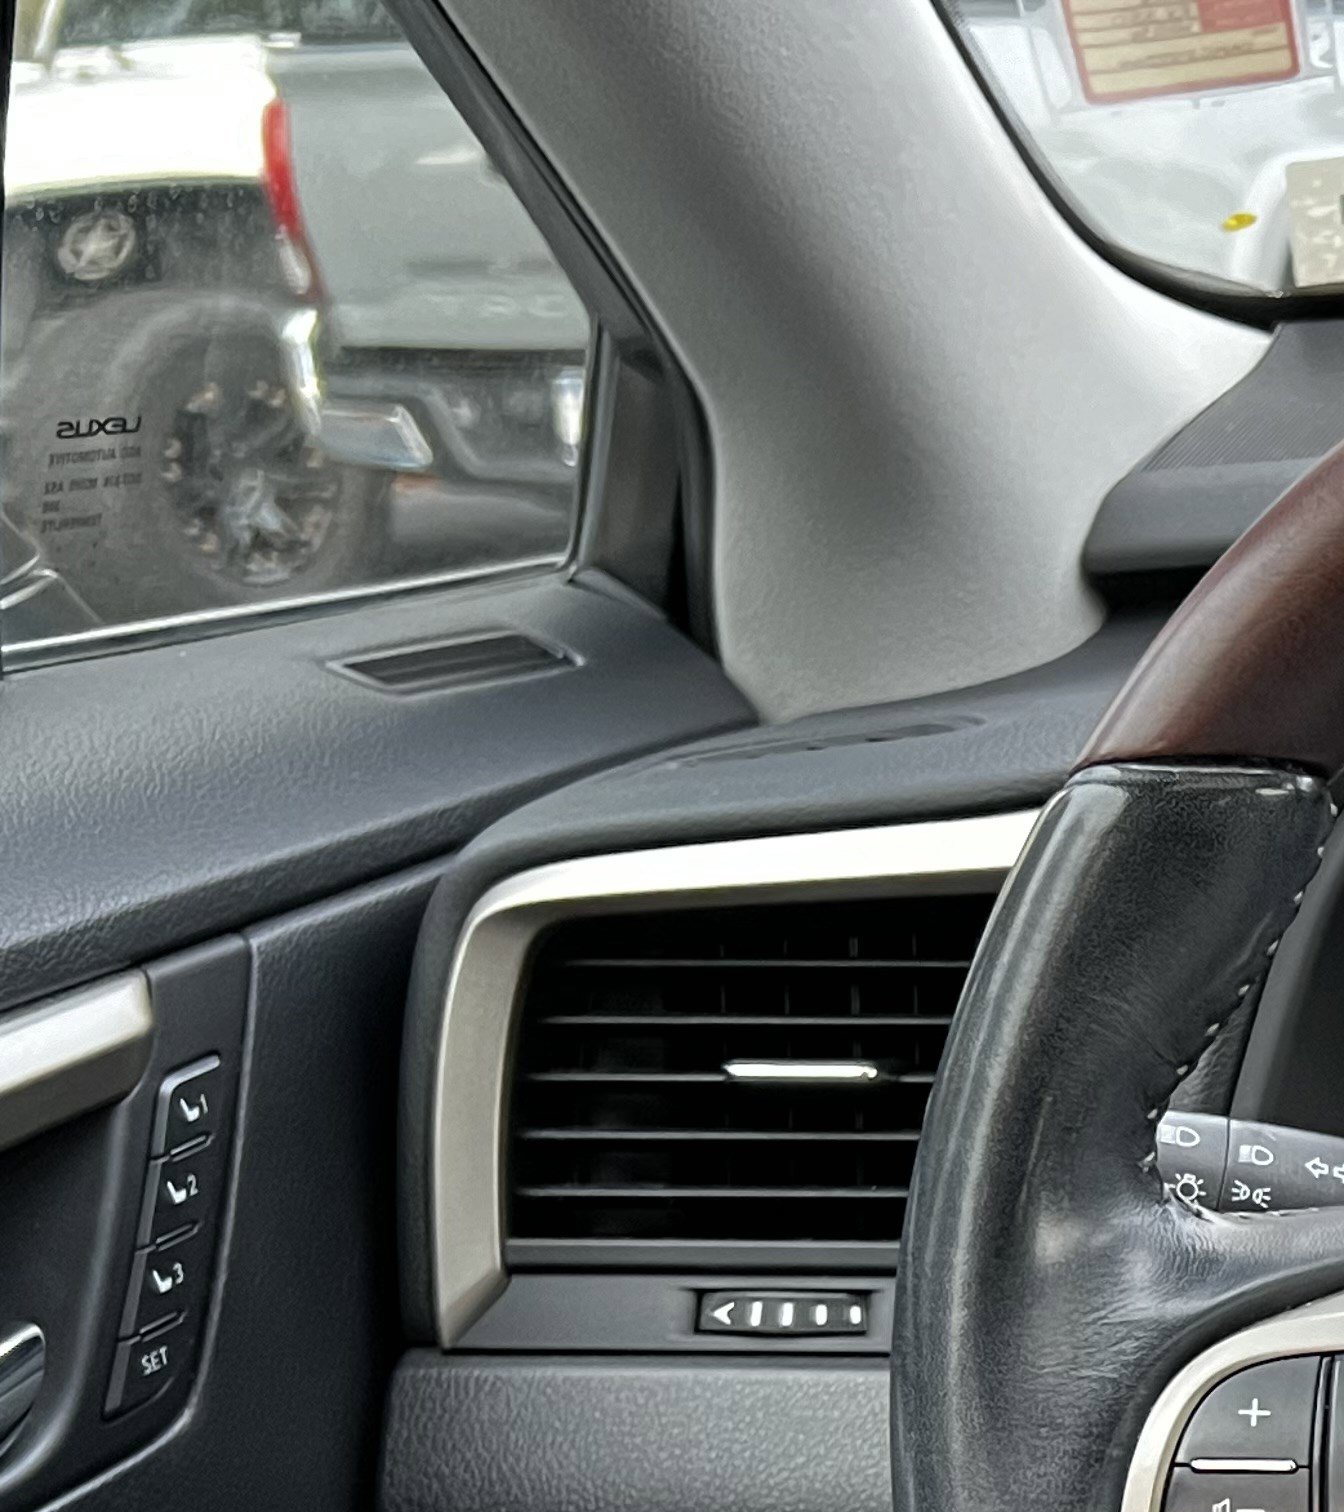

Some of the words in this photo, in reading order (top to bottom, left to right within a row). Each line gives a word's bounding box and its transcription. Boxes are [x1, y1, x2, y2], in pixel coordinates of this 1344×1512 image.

[187, 1174, 199, 1196] 2
[172, 1262, 184, 1285] 3
[141, 1346, 168, 1376] SET
